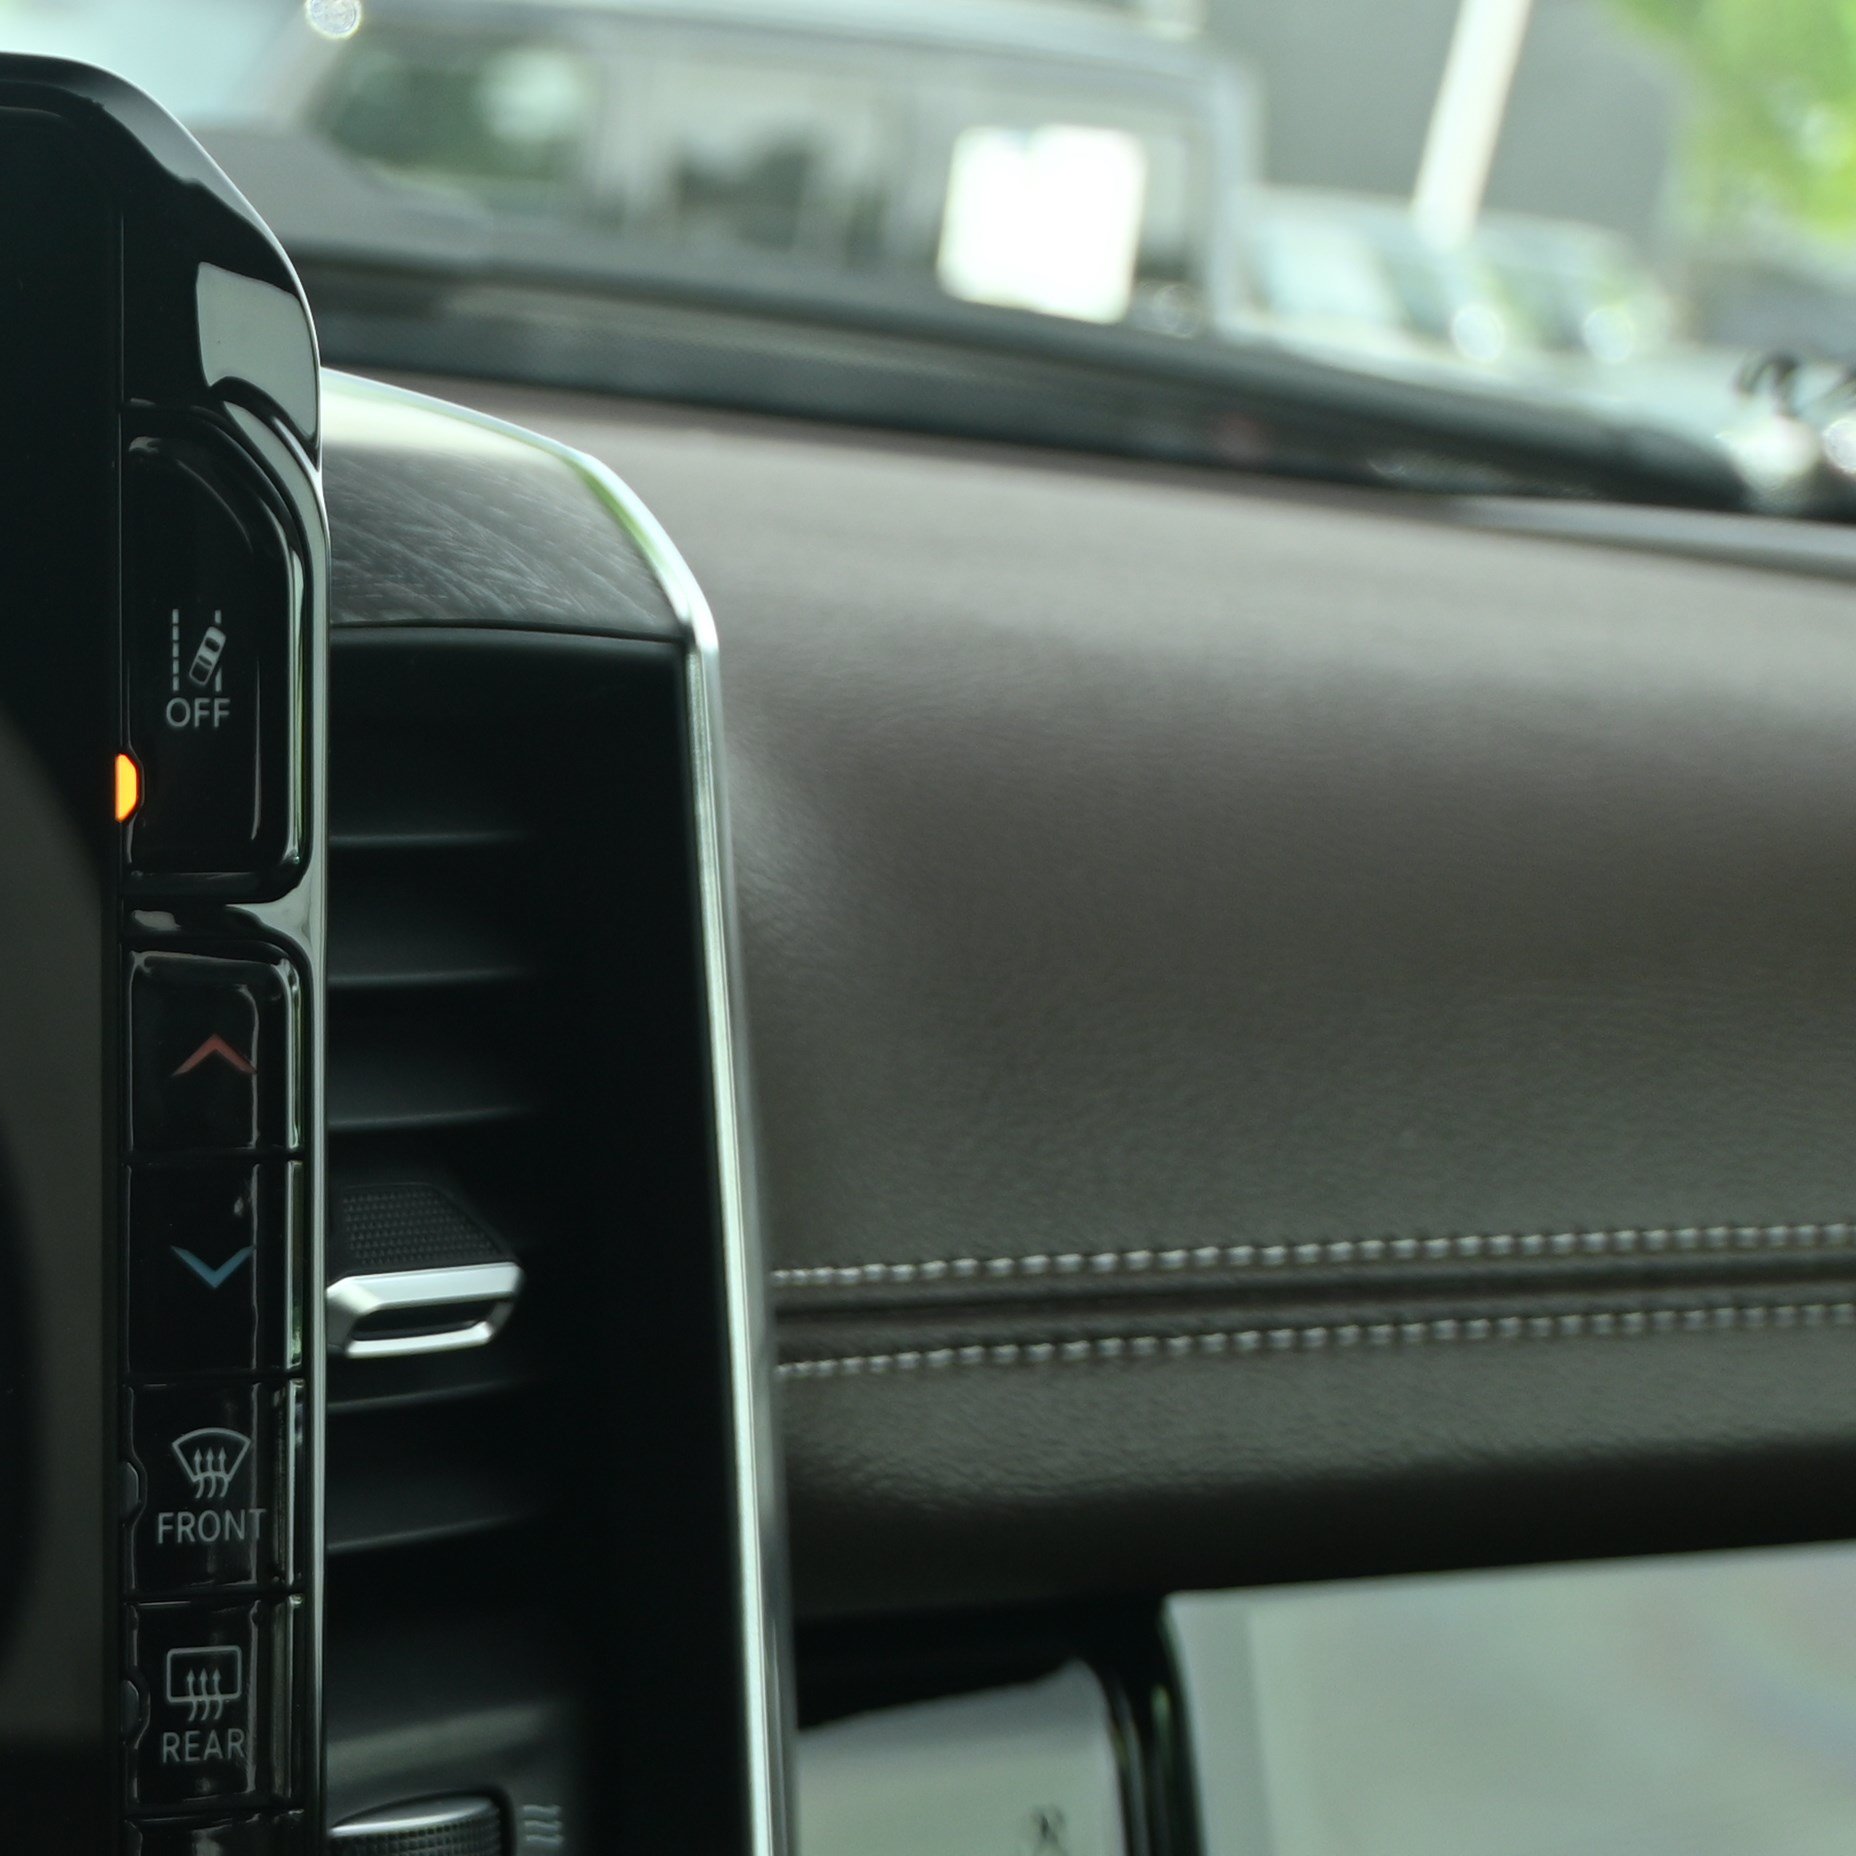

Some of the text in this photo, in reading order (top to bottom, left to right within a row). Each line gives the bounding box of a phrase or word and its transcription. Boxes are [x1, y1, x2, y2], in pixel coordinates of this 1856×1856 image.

[166, 698, 230, 729] OFF
[157, 1508, 266, 1545] FRONT
[161, 1730, 246, 1765] REAR
